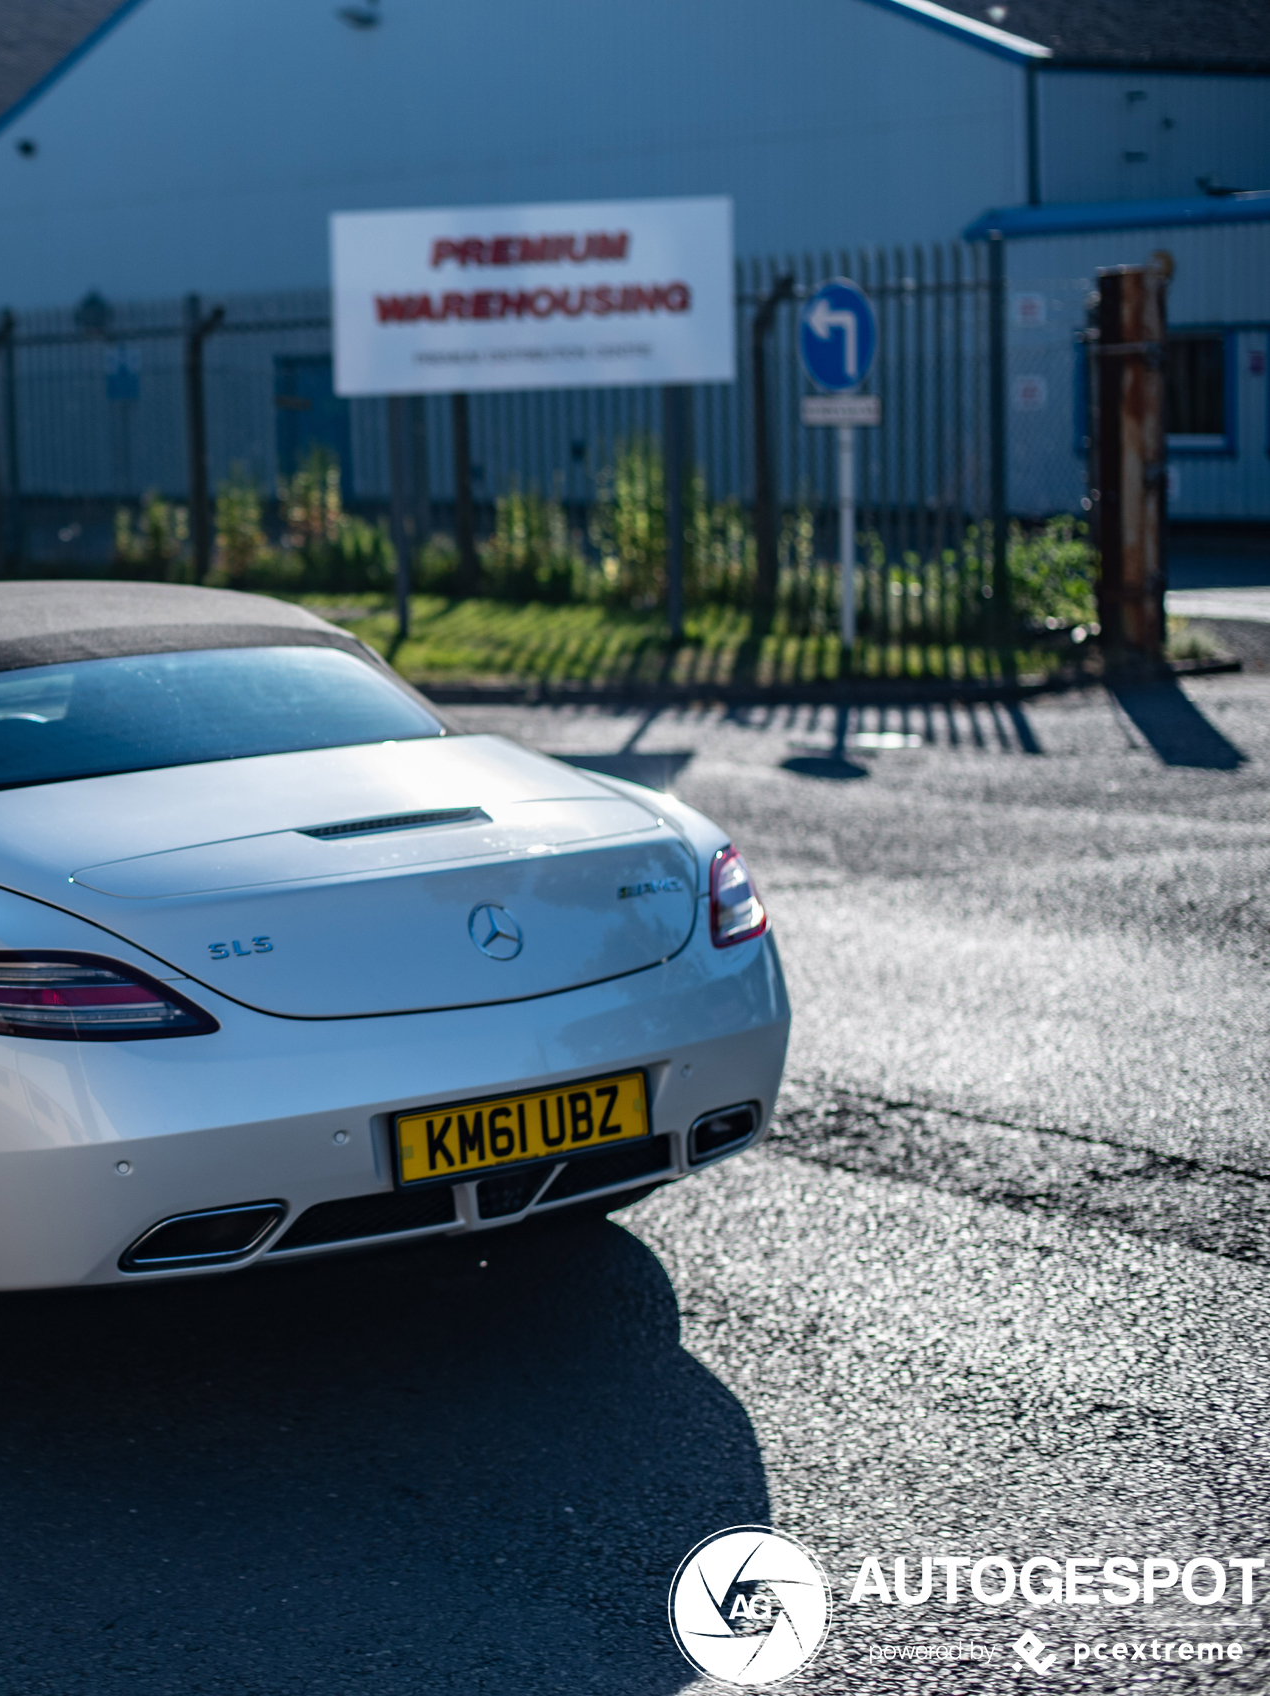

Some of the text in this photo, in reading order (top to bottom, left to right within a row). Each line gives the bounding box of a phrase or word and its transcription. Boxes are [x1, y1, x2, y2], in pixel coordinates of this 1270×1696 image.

[429, 229, 632, 269] PREMIUM
[374, 281, 692, 325] WAREHOUSING
[208, 936, 273, 960] SLS
[426, 1085, 622, 1170] KM61 UBZ
